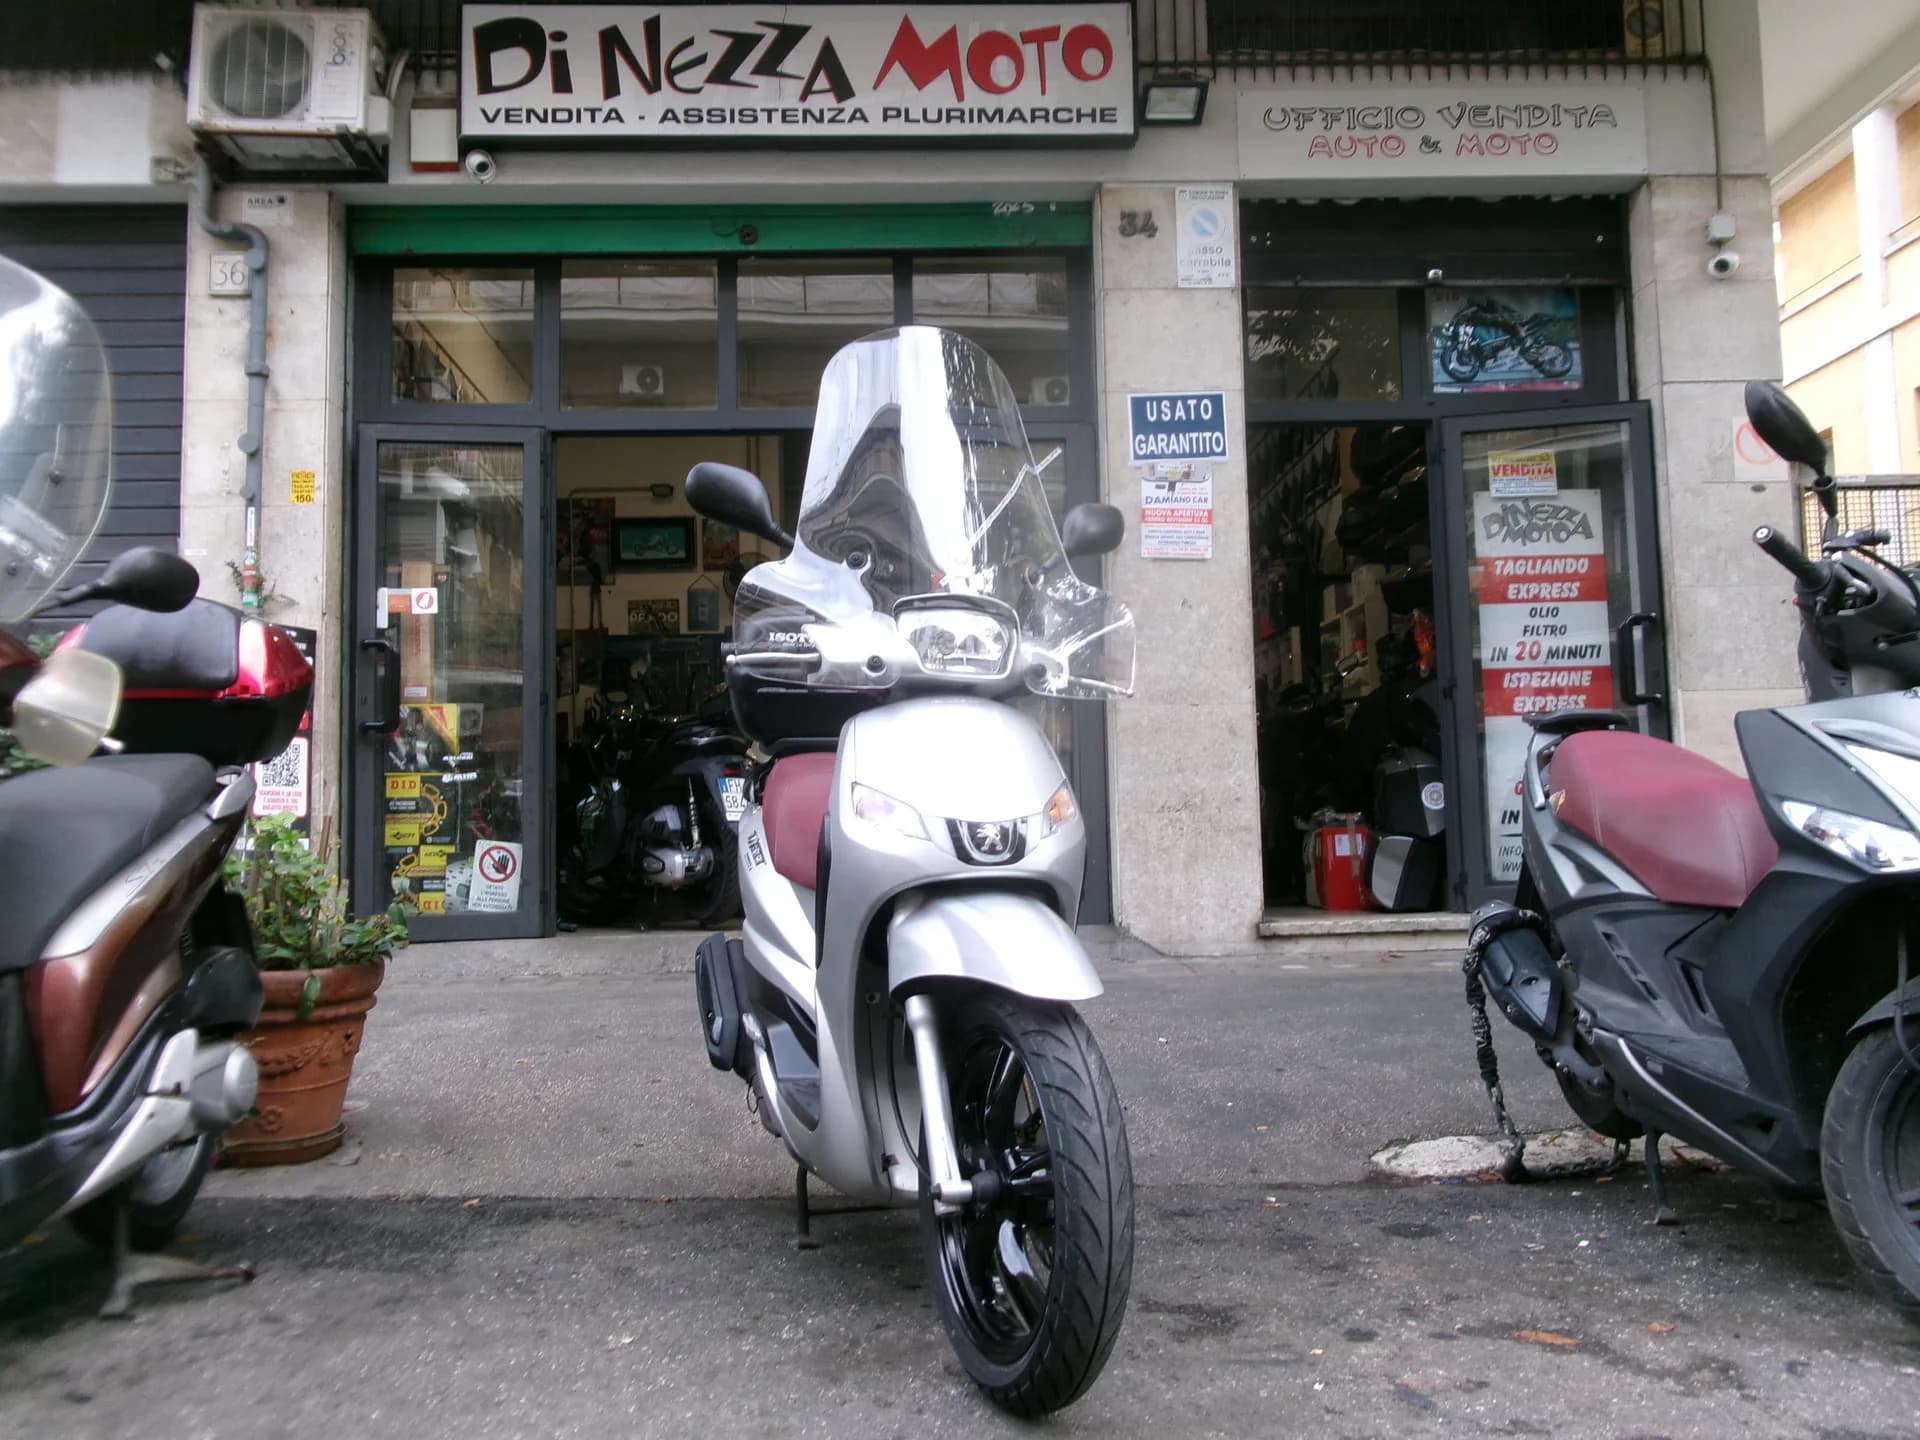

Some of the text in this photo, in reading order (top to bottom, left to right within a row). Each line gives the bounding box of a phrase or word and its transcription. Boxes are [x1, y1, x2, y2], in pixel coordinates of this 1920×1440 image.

[872, 13, 1113, 102] MOTO
[480, 107, 625, 124] VENDITA
[658, 107, 870, 124] ASSISTENZA
[882, 107, 1118, 124] PLURIMARCHE
[1263, 102, 1618, 131] UFFICIO VENDITA
[1308, 133, 1560, 159] AUTO & MOTO
[1118, 211, 1159, 238] 34
[213, 260, 246, 285] 36
[1146, 398, 1213, 422] USATO
[1134, 431, 1224, 456] GARANTITO
[1491, 462, 1554, 476] VENDITA
[1494, 558, 1589, 576] TAGLIANDO
[1507, 581, 1581, 599] EXPRESS
[1529, 606, 1560, 618] OLIO
[1522, 624, 1568, 637] FILTRO
[1490, 640, 1602, 662] IN 20 MINUTI
[1503, 670, 1593, 688] ISPEZIONE
[1513, 694, 1587, 713] EXPRESS
[1501, 809, 1520, 825] IN
